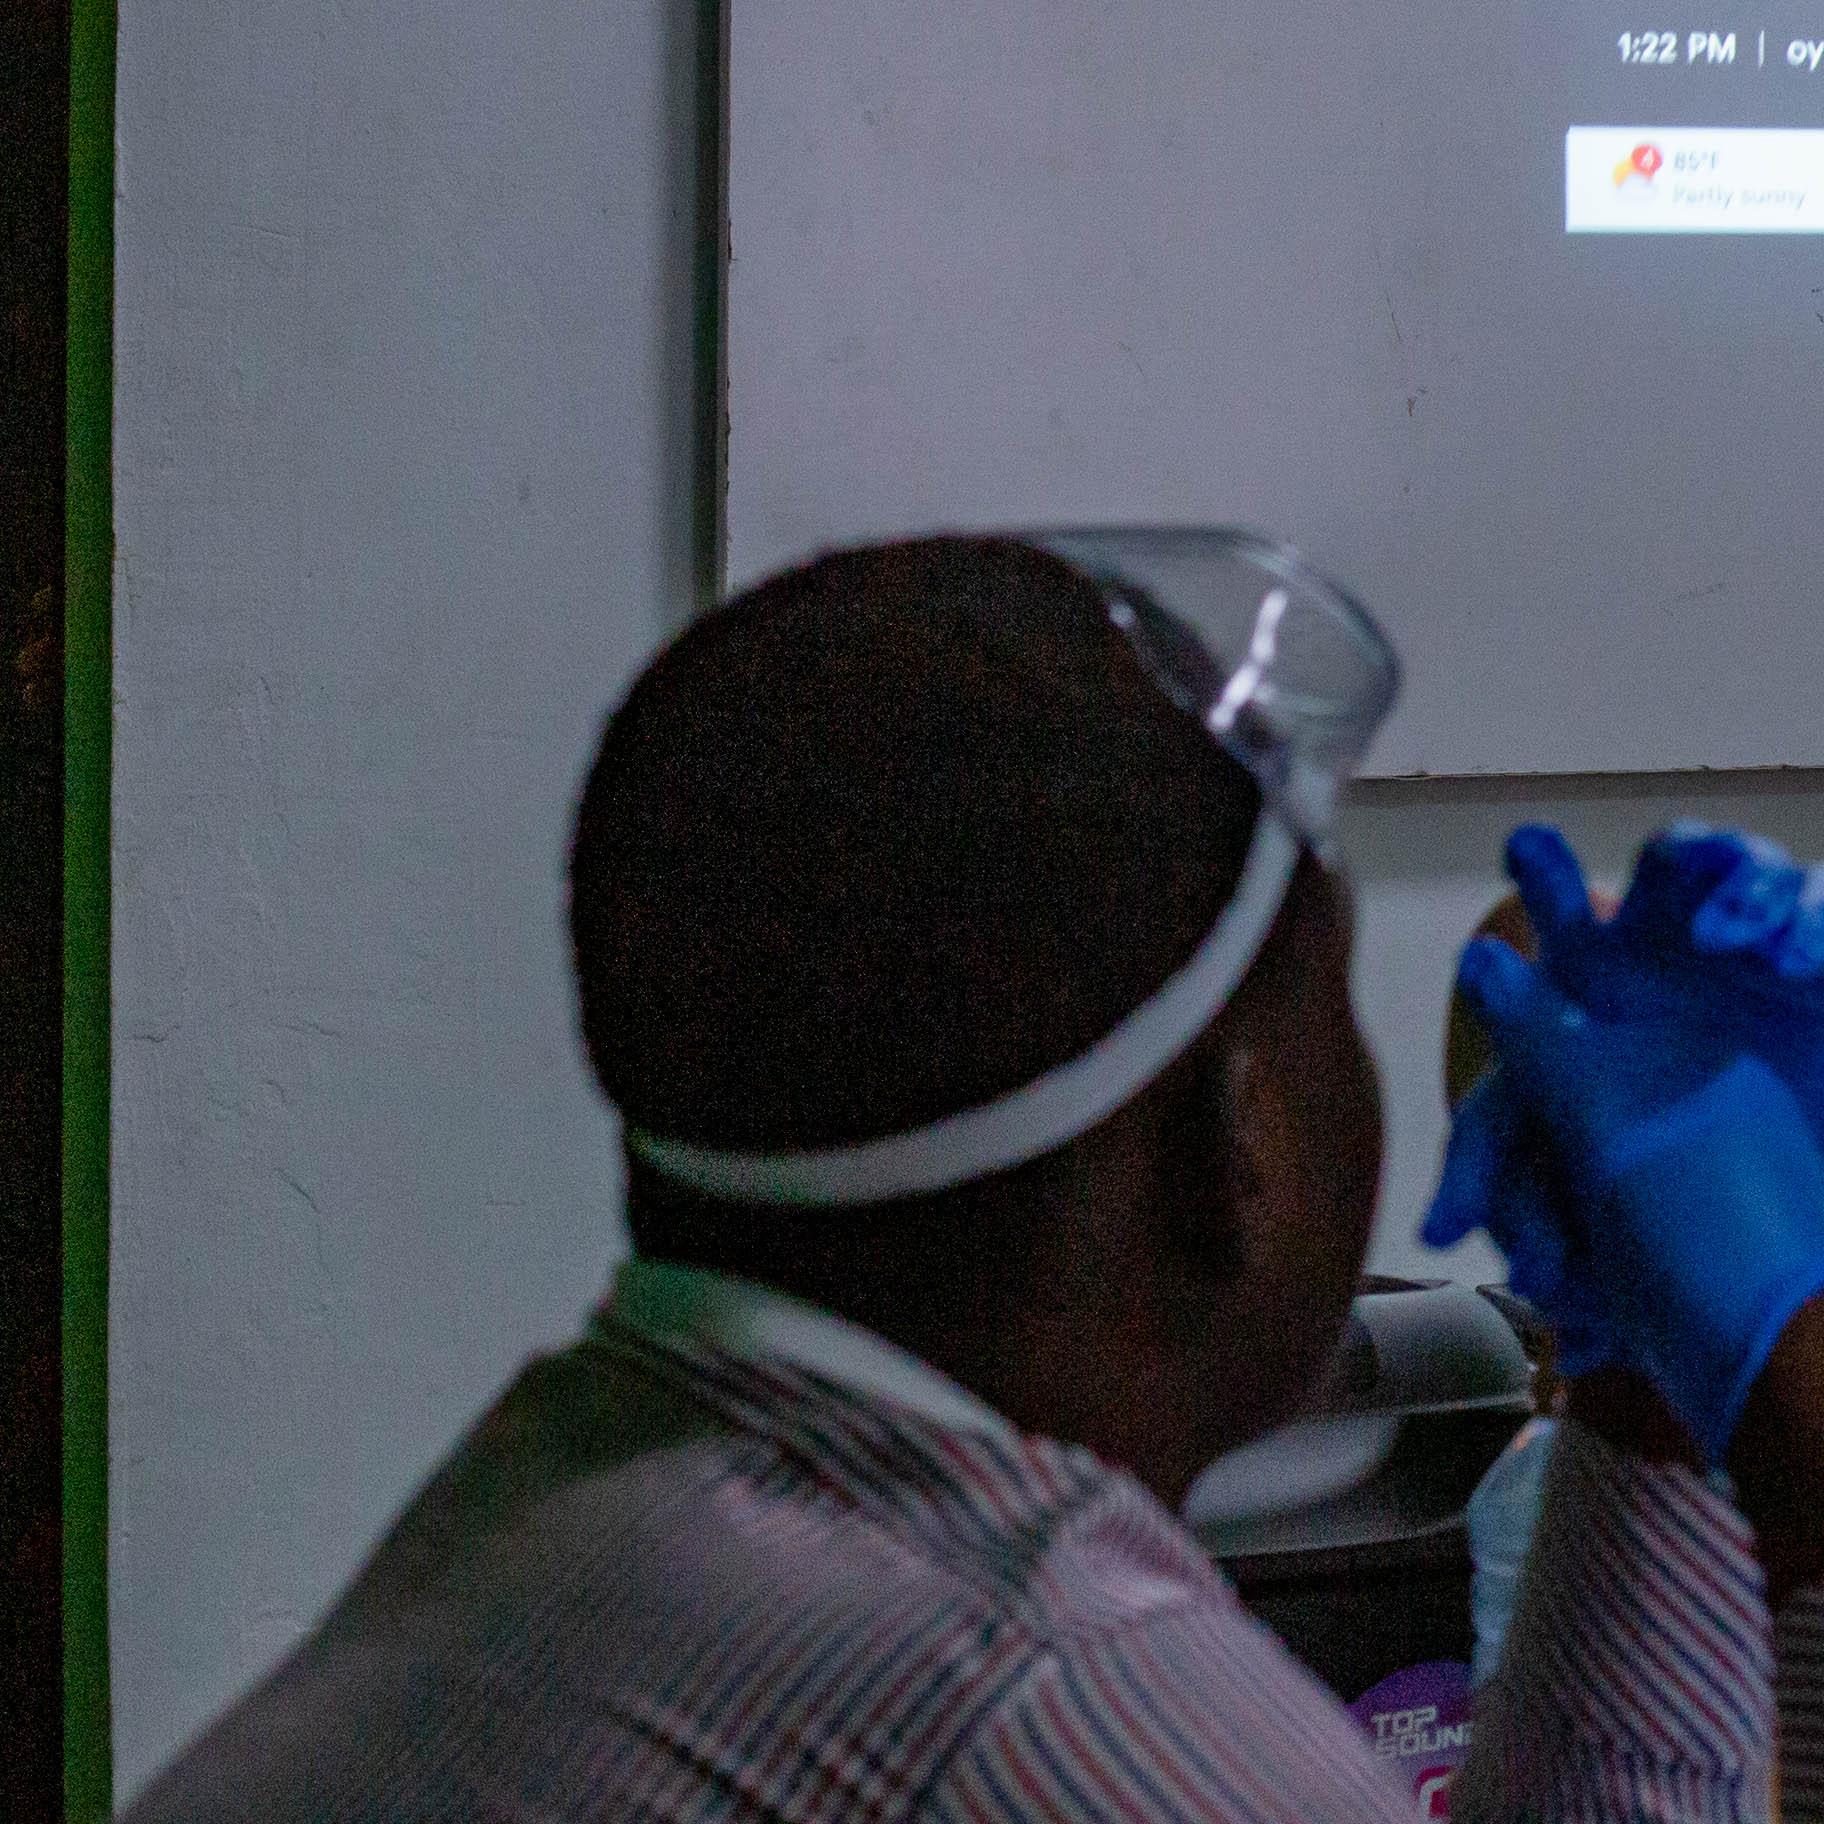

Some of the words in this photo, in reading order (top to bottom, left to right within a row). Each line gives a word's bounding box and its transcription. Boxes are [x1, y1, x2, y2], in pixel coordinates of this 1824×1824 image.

[1617, 32, 1677, 64] 1:22
[1687, 32, 1737, 65] PM
[1371, 1705, 1437, 1737] TOP
